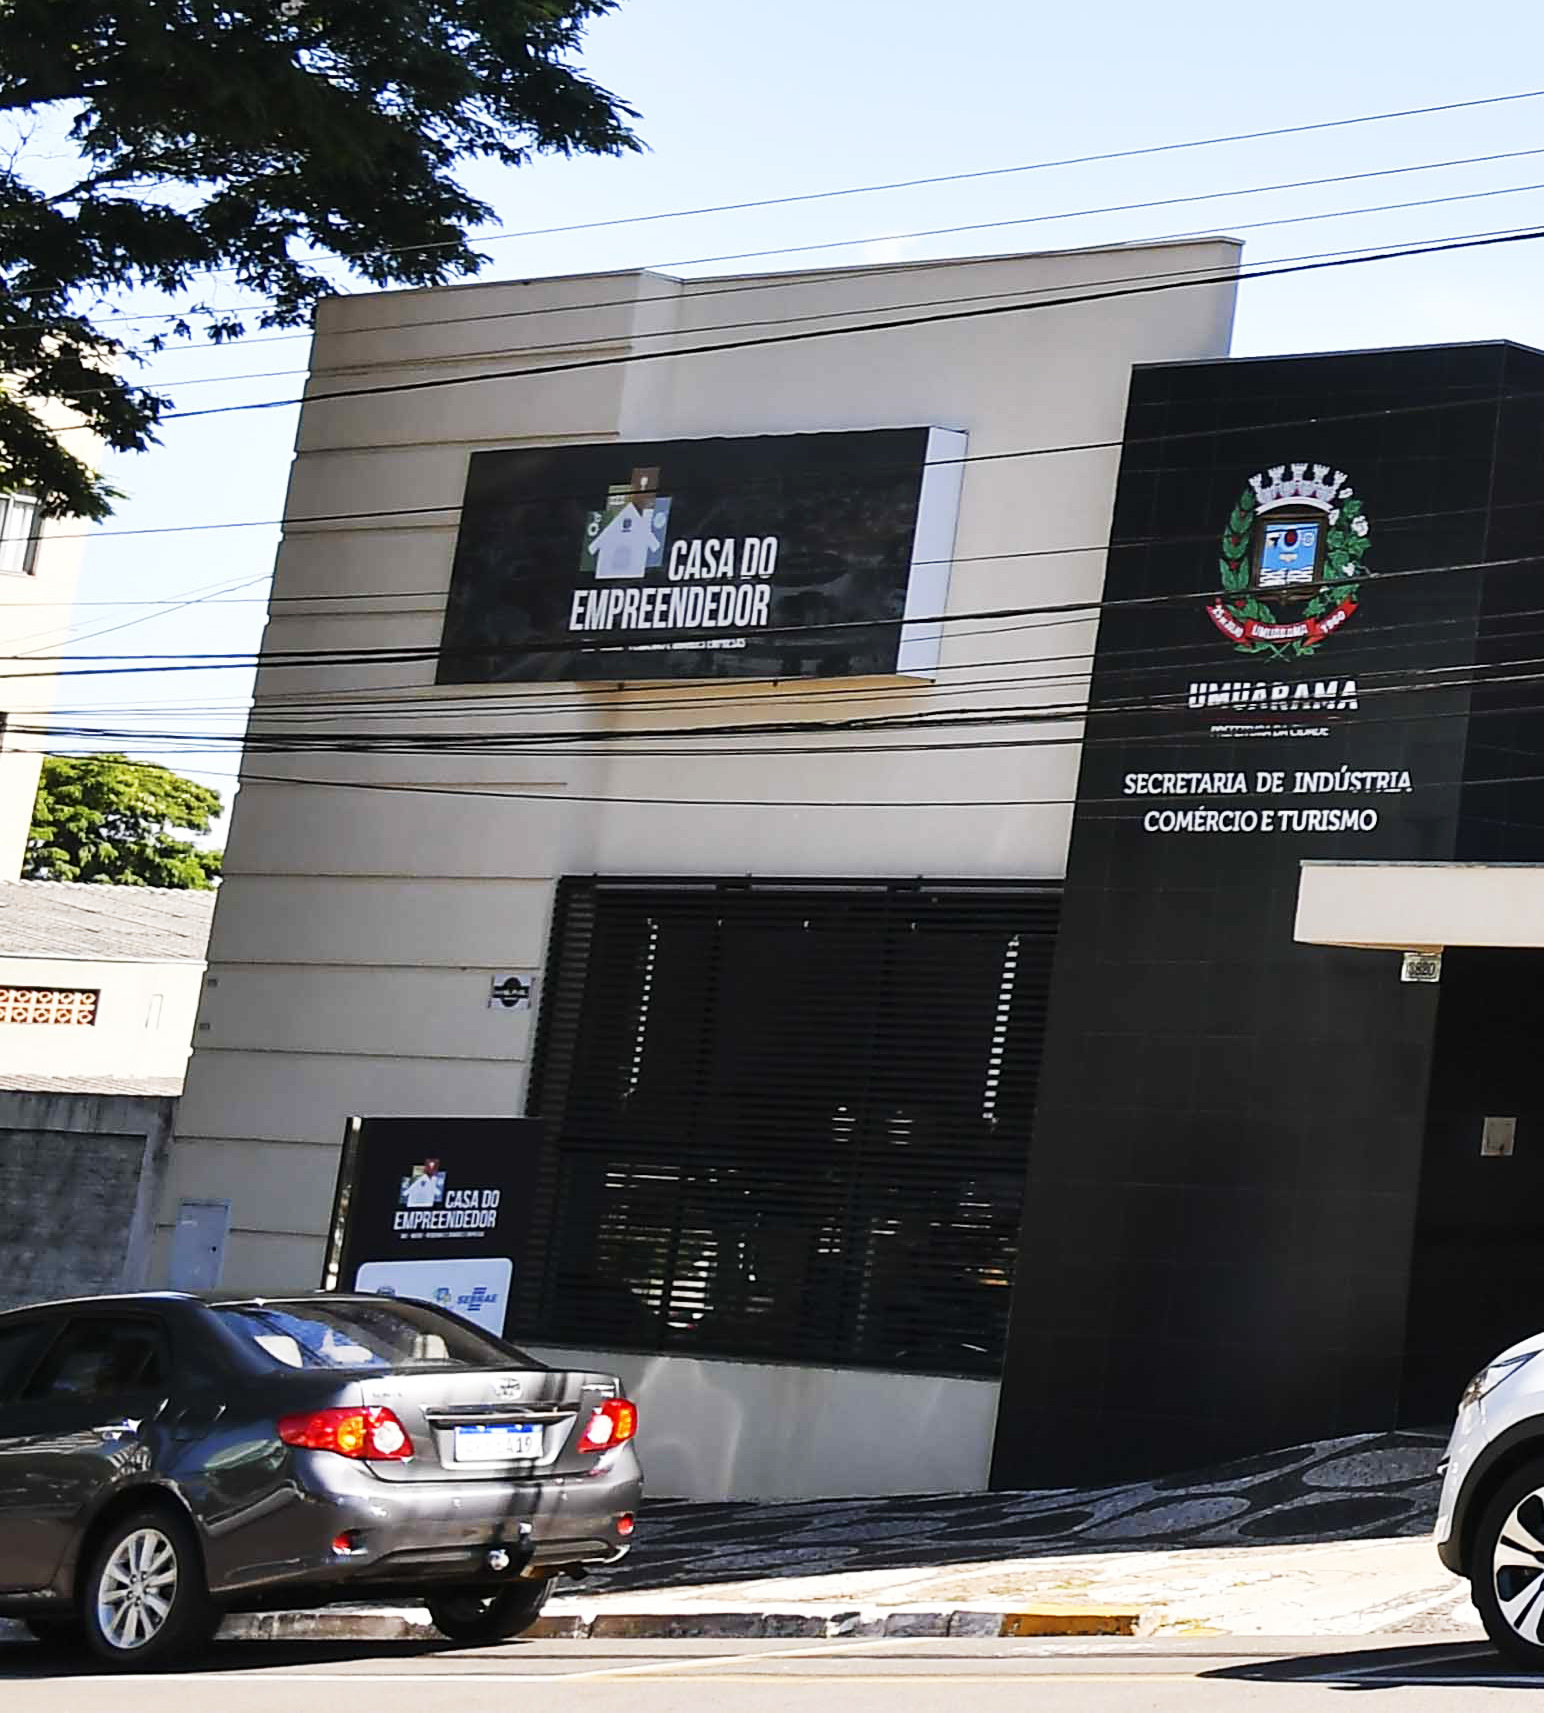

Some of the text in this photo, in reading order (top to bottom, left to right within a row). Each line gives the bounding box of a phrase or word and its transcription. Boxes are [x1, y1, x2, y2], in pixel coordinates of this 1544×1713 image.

[667, 536, 778, 582] CASA DO
[568, 584, 771, 632] EMPREENDEDOR
[1188, 680, 1359, 710] UMUARAMA
[1123, 764, 1413, 794] SECRETARIA DE INDÚSTRIA
[1143, 805, 1378, 832] COMÉRCIO E TURISMO
[445, 1189, 501, 1209] CASA DO
[393, 1210, 497, 1231] EMPREENDEDOR
